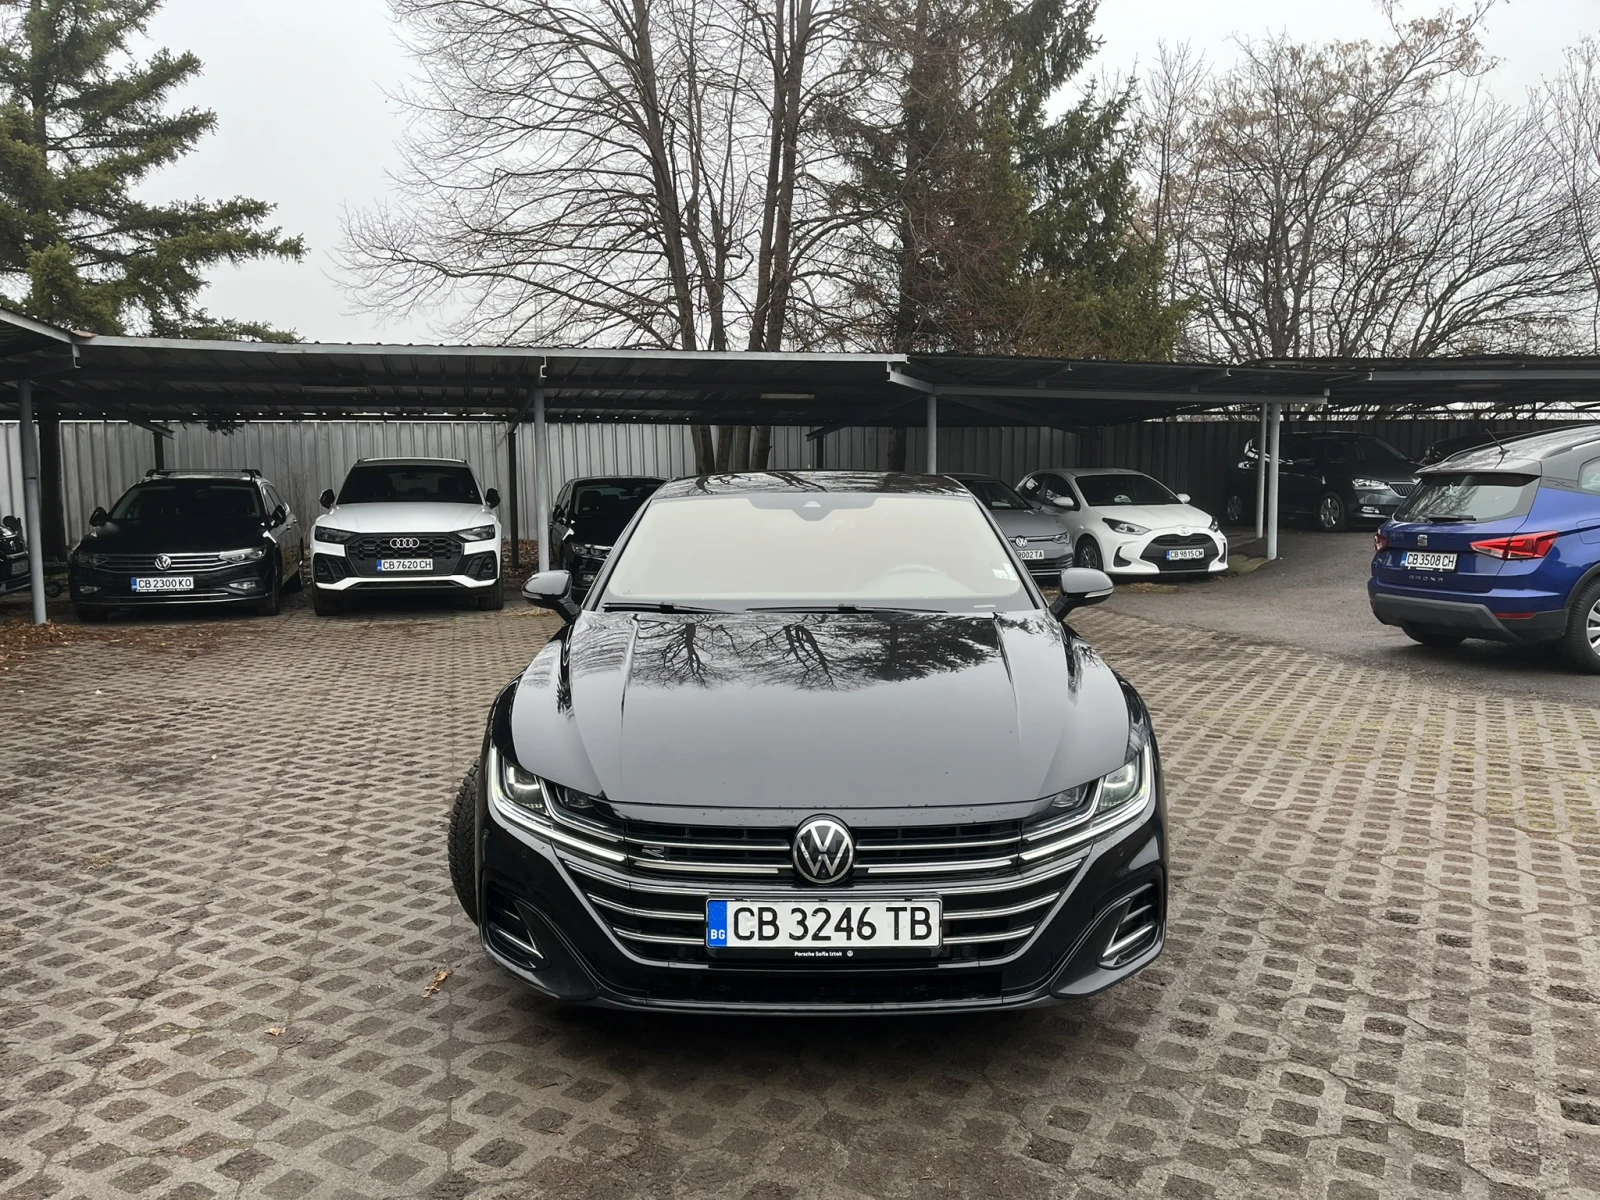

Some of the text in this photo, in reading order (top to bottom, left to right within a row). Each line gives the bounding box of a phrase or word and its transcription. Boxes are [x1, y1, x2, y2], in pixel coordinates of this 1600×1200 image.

[383, 560, 431, 569] CB 7620 CH
[1407, 553, 1455, 567] CB 3508 CH
[138, 578, 192, 588] CB 2300 KO
[733, 906, 932, 941] CB 3246 TB
[710, 929, 726, 939] BG
